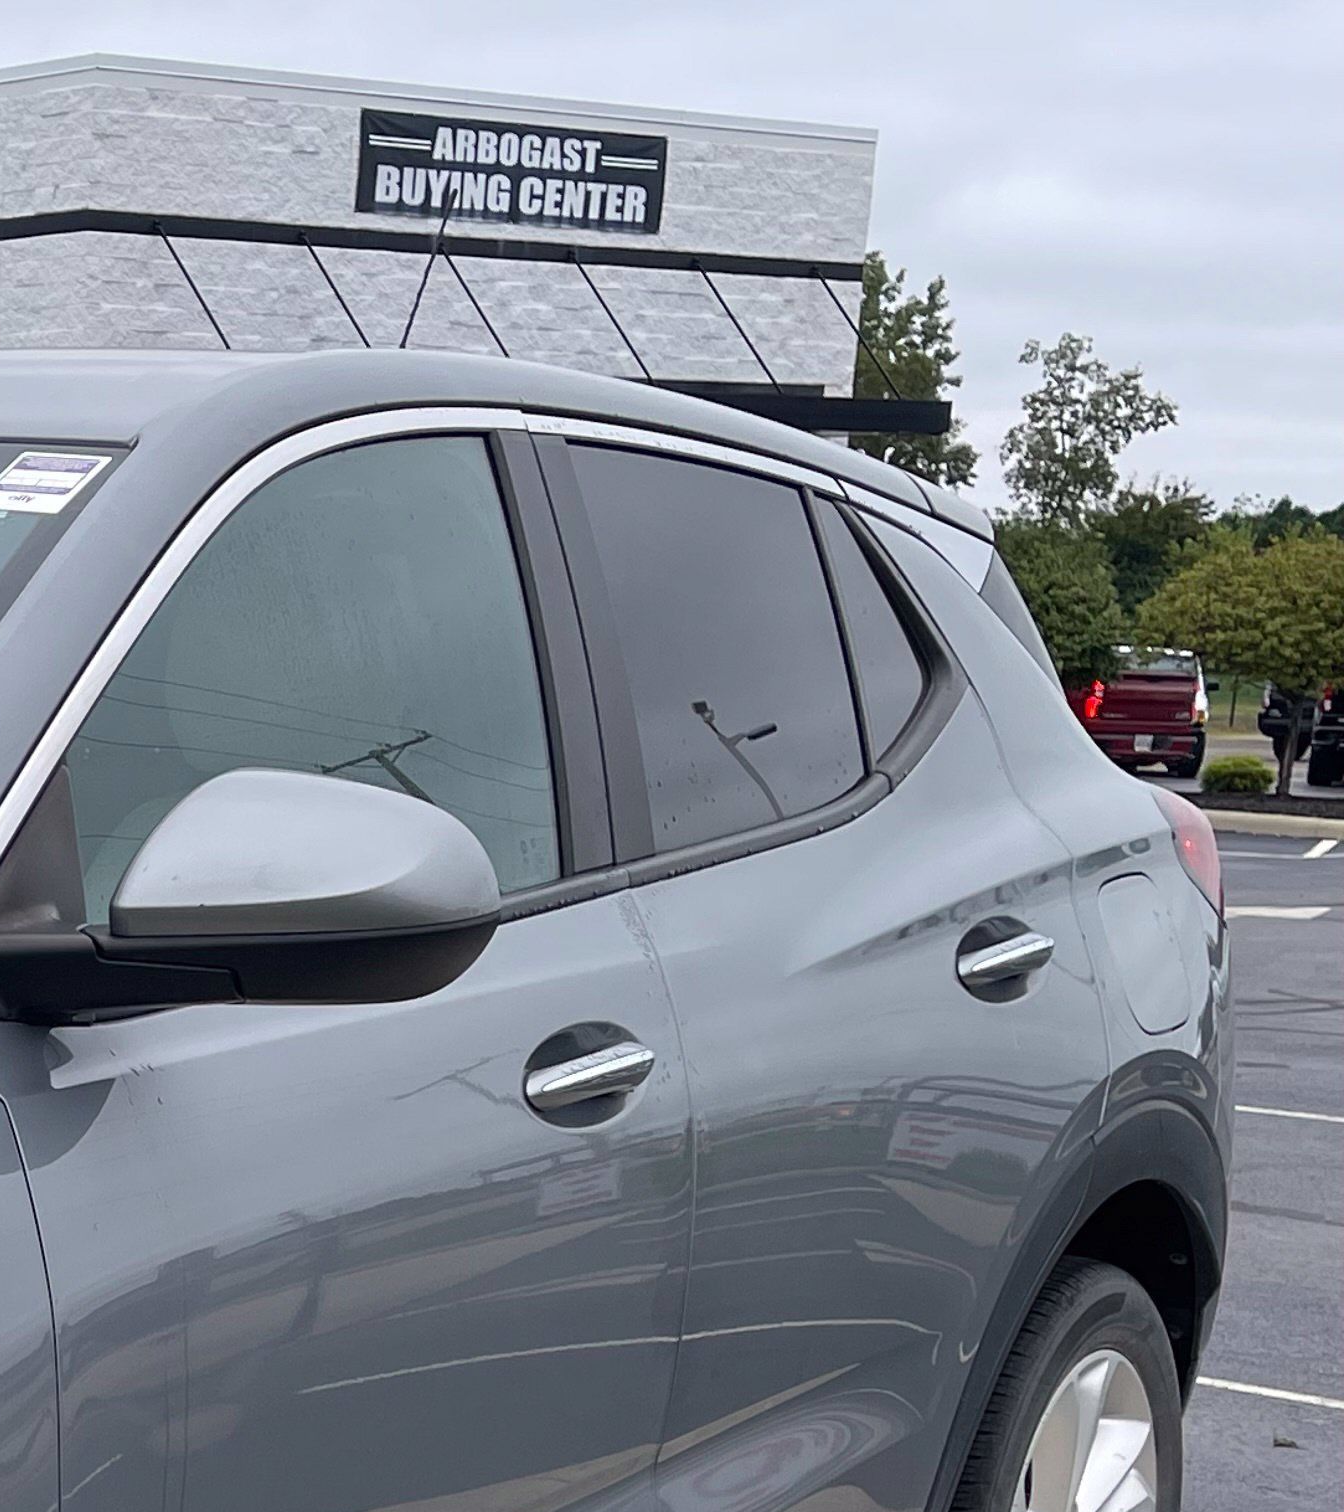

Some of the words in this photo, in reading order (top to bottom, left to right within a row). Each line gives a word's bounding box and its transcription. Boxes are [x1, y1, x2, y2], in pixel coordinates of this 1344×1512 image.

[432, 126, 603, 174] ARBOGAST
[374, 164, 512, 213] BUYING
[518, 176, 648, 224] CENTER
